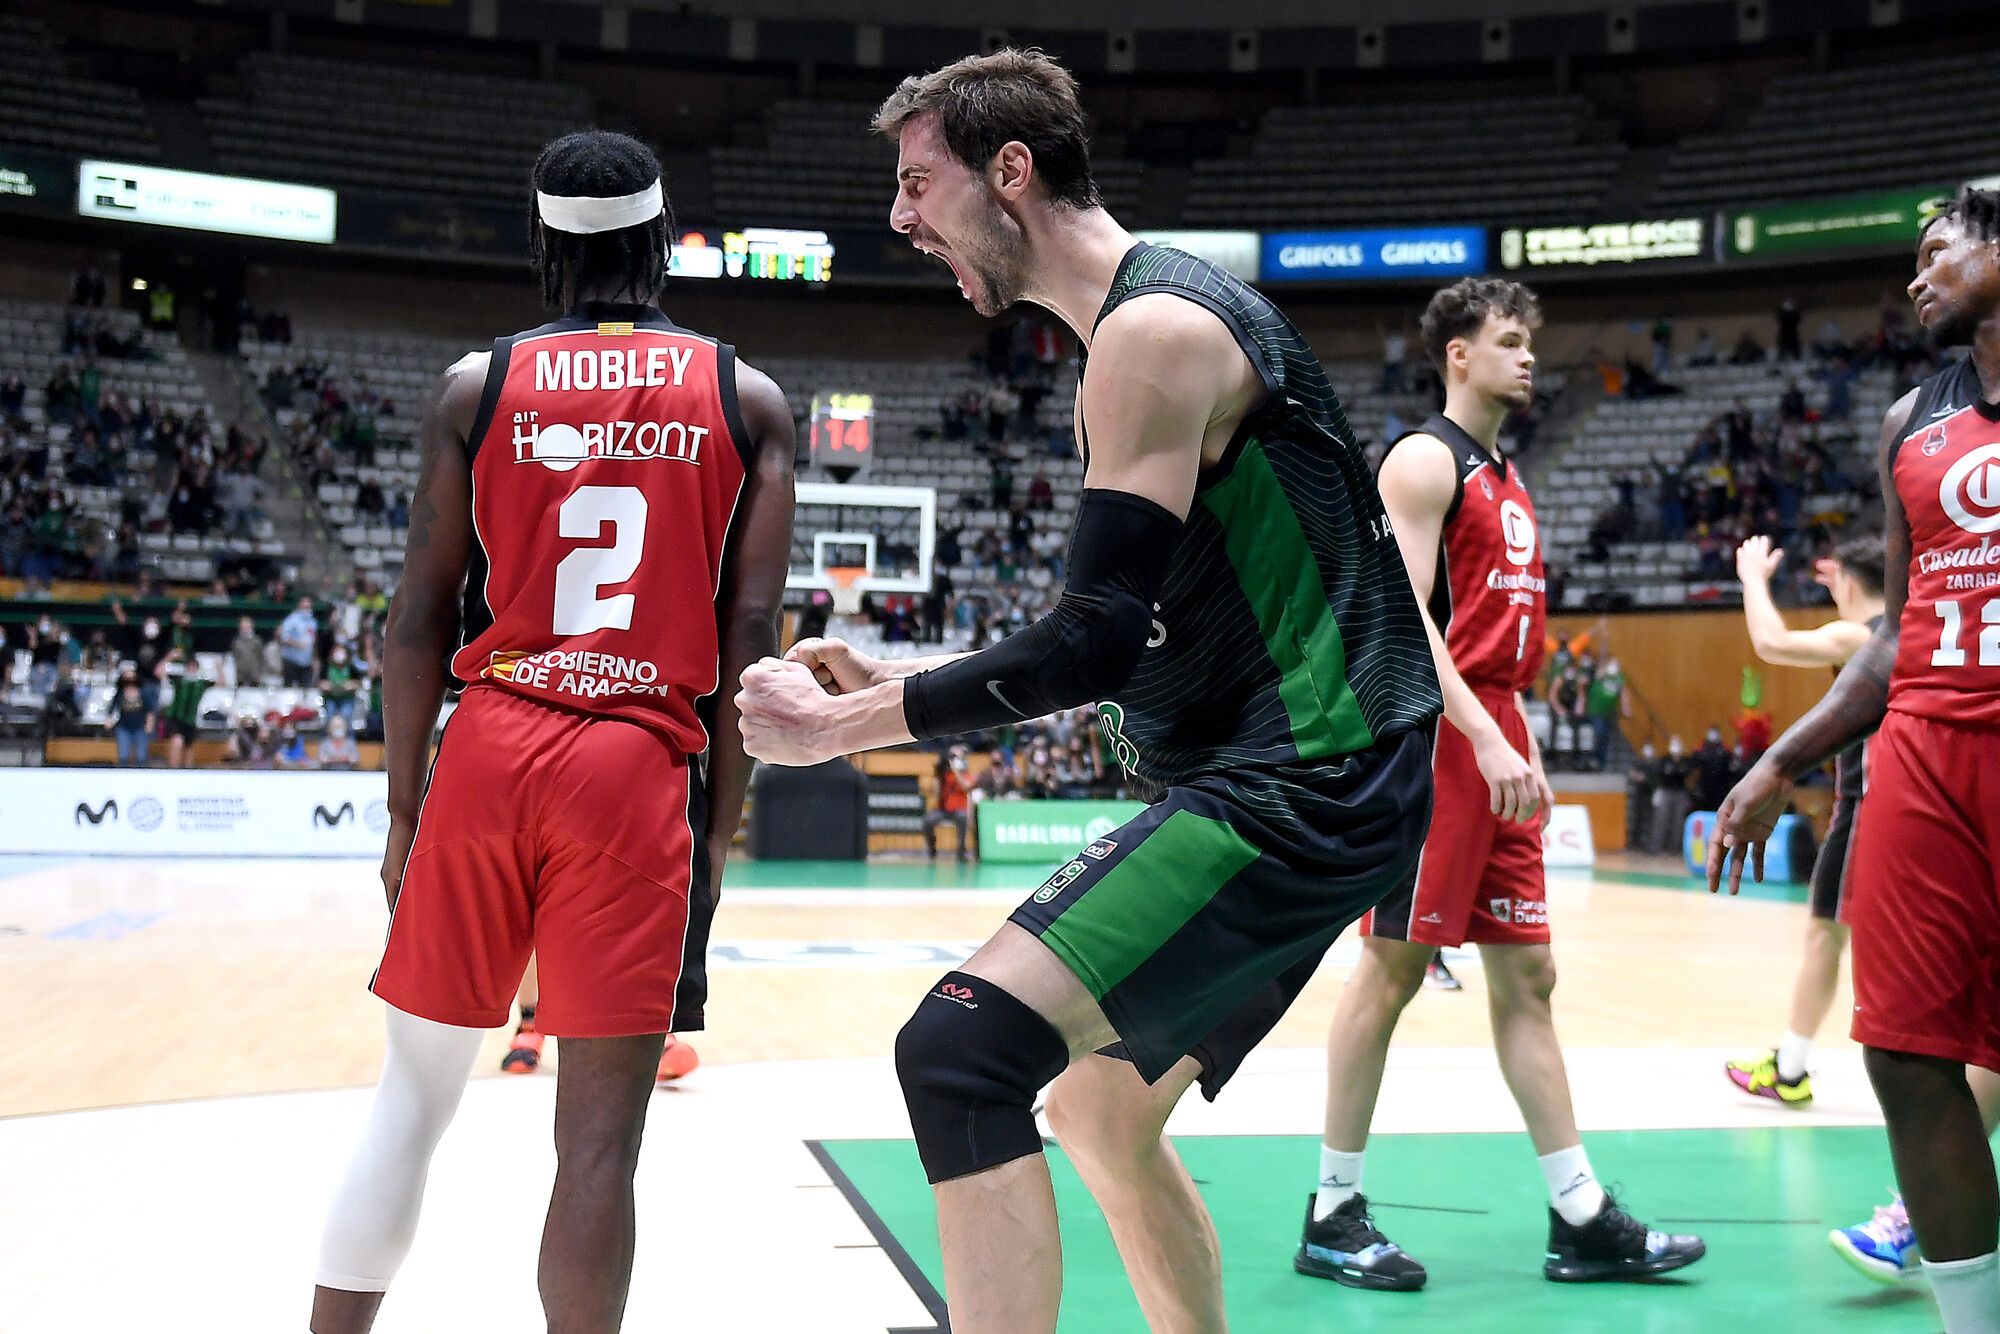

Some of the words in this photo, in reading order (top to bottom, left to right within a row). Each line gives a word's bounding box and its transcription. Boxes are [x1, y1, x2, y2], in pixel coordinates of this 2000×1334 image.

[1279, 245, 1364, 268] GRIFOLS
[1381, 241, 1466, 266] GRIFOLS
[535, 347, 694, 391] MOBLEY
[513, 411, 539, 424] air
[825, 419, 870, 453] 14
[553, 485, 648, 635] 2
[515, 662, 550, 689] DE
[995, 825, 1081, 844] BADALONA
